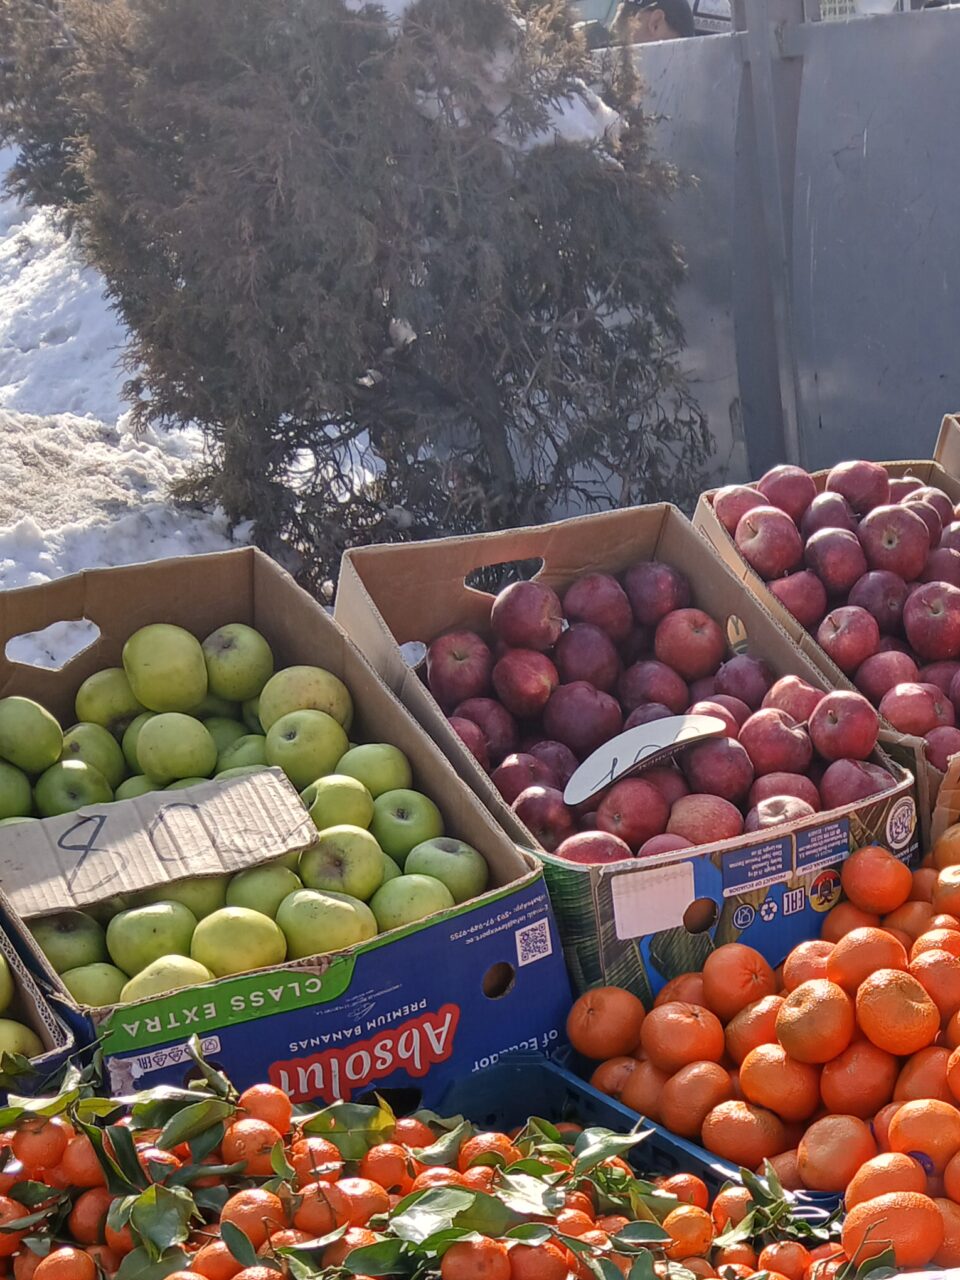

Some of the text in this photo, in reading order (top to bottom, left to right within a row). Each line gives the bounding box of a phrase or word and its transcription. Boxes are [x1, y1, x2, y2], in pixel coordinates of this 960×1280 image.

[230, 978, 322, 1011] CLASS
[122, 1002, 217, 1038] EXTRA
[366, 998, 428, 1032] PREMIUM
[279, 1012, 453, 1099] Absolut
[289, 1025, 363, 1053] BANANAS
